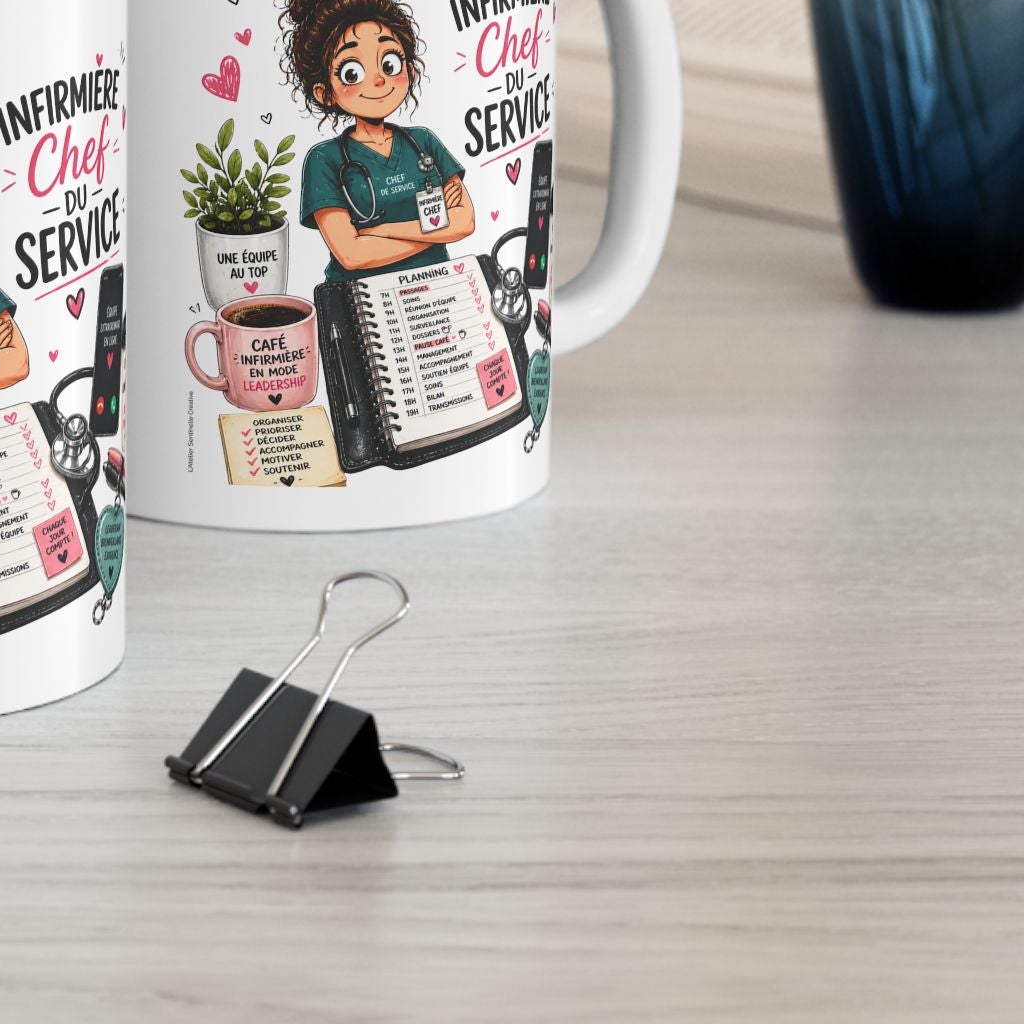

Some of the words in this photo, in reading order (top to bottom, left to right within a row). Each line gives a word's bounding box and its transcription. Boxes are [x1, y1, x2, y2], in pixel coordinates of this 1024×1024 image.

[476, 8, 543, 77] Chef
[506, 68, 523, 94] DU
[465, 73, 550, 157] SERVICE
[28, 114, 110, 197] Chef
[386, 174, 405, 184] CHEF
[392, 182, 416, 194] SERVICE
[65, 184, 86, 215] DU
[424, 204, 441, 216] CHEF
[15, 188, 120, 290] SERVICE
[217, 253, 237, 265] UNE
[243, 249, 278, 263] ÉQUIPE
[230, 267, 245, 279] AU
[248, 266, 268, 278] TOP
[400, 285, 429, 295] PASSAGES
[403, 296, 420, 304] SOINS
[405, 304, 431, 313] RÉUNION
[407, 308, 449, 321] ORGANISATION
[410, 317, 450, 331] SURVEILLANCE
[412, 329, 440, 340] DOSSIERS
[252, 334, 287, 352] CAFÉ
[414, 340, 434, 350] PAUSE
[435, 336, 450, 346] CAFÉ
[241, 349, 306, 365] INFIRMIÈRE
[417, 345, 457, 360] MANAGEMENT
[420, 351, 473, 370] ACCOMPAGNEMENT
[484, 356, 504, 371] CHAQUE
[250, 368, 264, 377] EN
[269, 365, 298, 376] MODE
[422, 369, 448, 380] SOUTIEN
[449, 363, 469, 374] ÉQUIPE
[489, 365, 502, 376] JOUR
[243, 375, 306, 391] LEADERSHIP
[424, 381, 443, 390] SOINS
[427, 392, 444, 401] BILAN
[253, 415, 303, 426] ORGANISER
[255, 425, 302, 435] PRIORISER
[257, 435, 296, 445] DÉCIDER
[260, 440, 325, 454] ACCOMPAGNER
[262, 453, 303, 465] MOTIVER
[264, 462, 310, 475] SOUTENIR
[42, 517, 67, 535] CHAQUE
[0, 527, 25, 542] ÉQUIPE
[49, 529, 66, 543] JOUR
[46, 538, 71, 555] COMPTE
